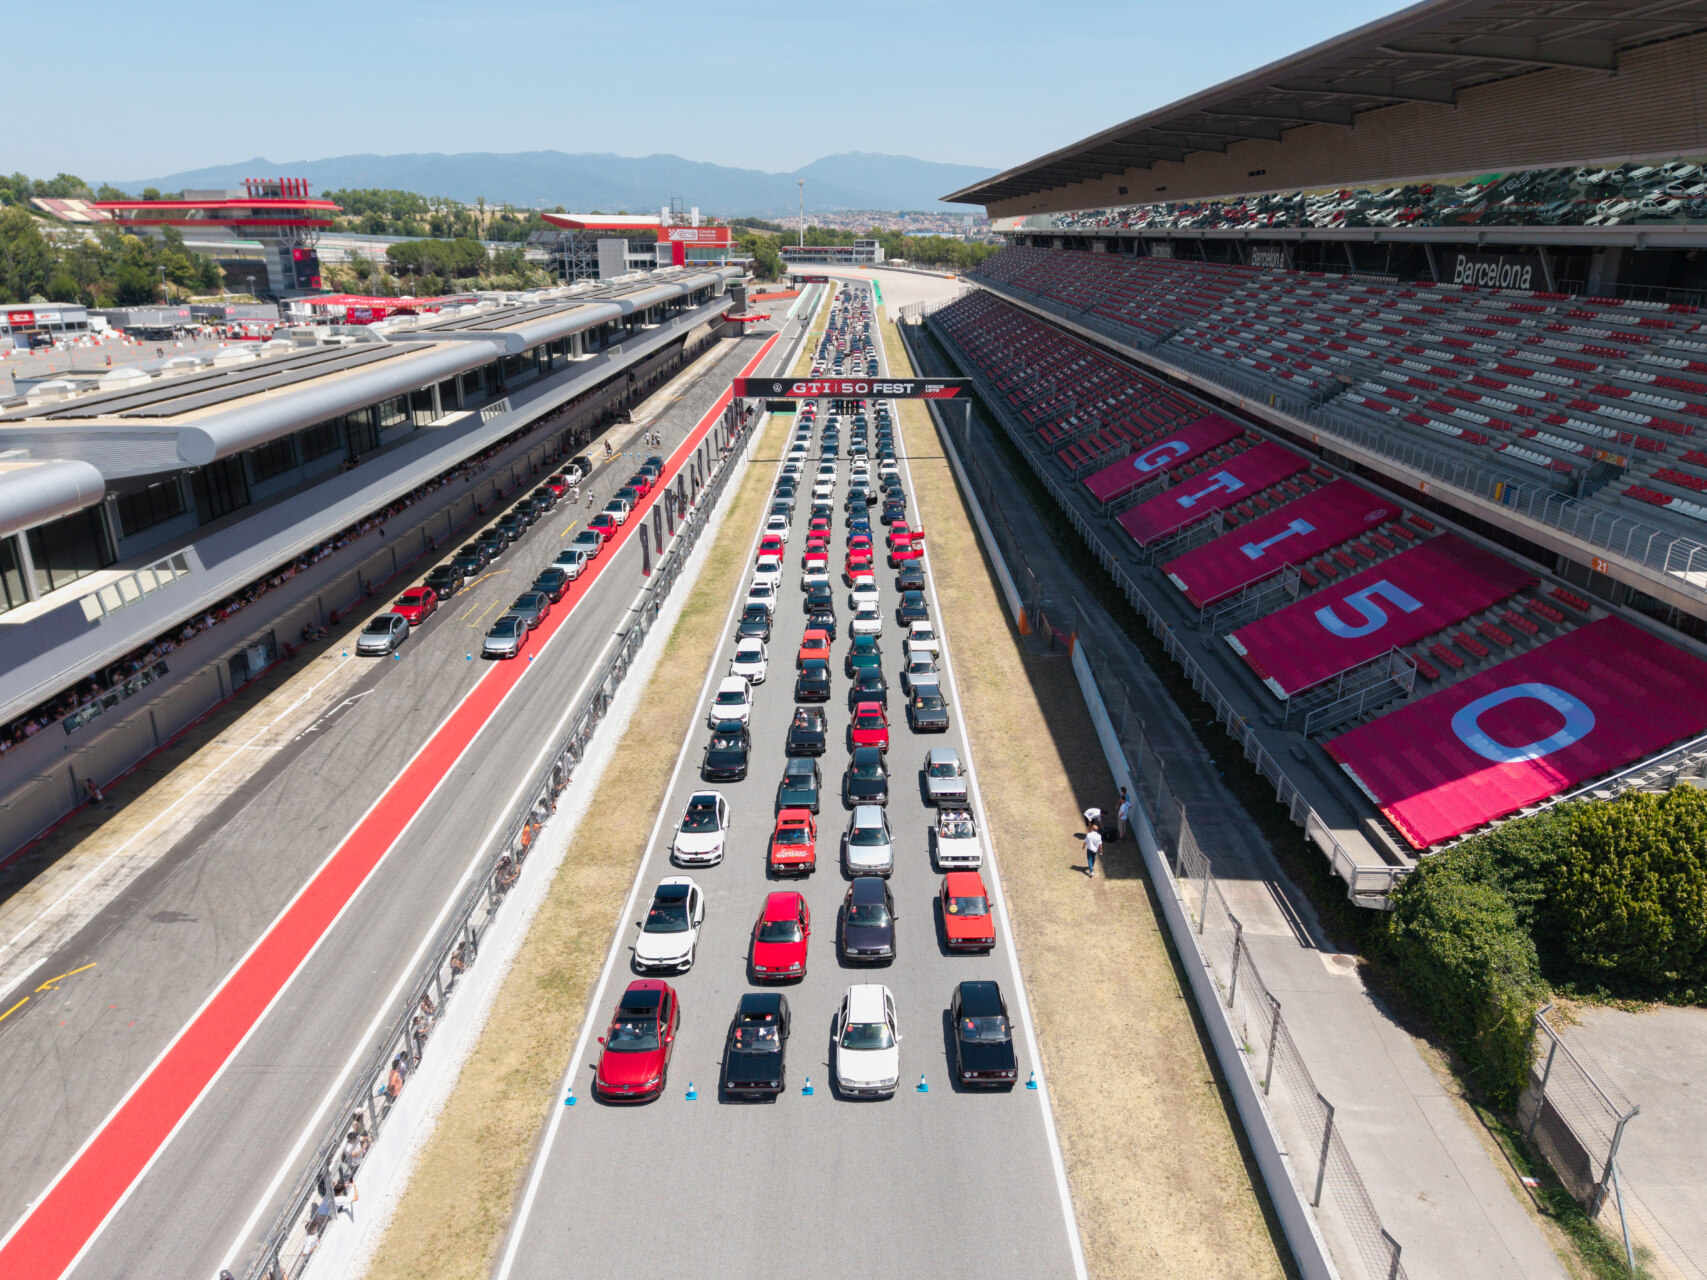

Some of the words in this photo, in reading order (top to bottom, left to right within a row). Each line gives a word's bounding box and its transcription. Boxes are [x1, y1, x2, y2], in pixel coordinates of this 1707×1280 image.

[1251, 247, 1285, 268] Barcelona
[1453, 254, 1532, 290] Barcelona
[792, 382, 831, 393] GTI
[841, 382, 869, 393] 50
[873, 383, 915, 394] FEST
[1597, 560, 1607, 573] 21
